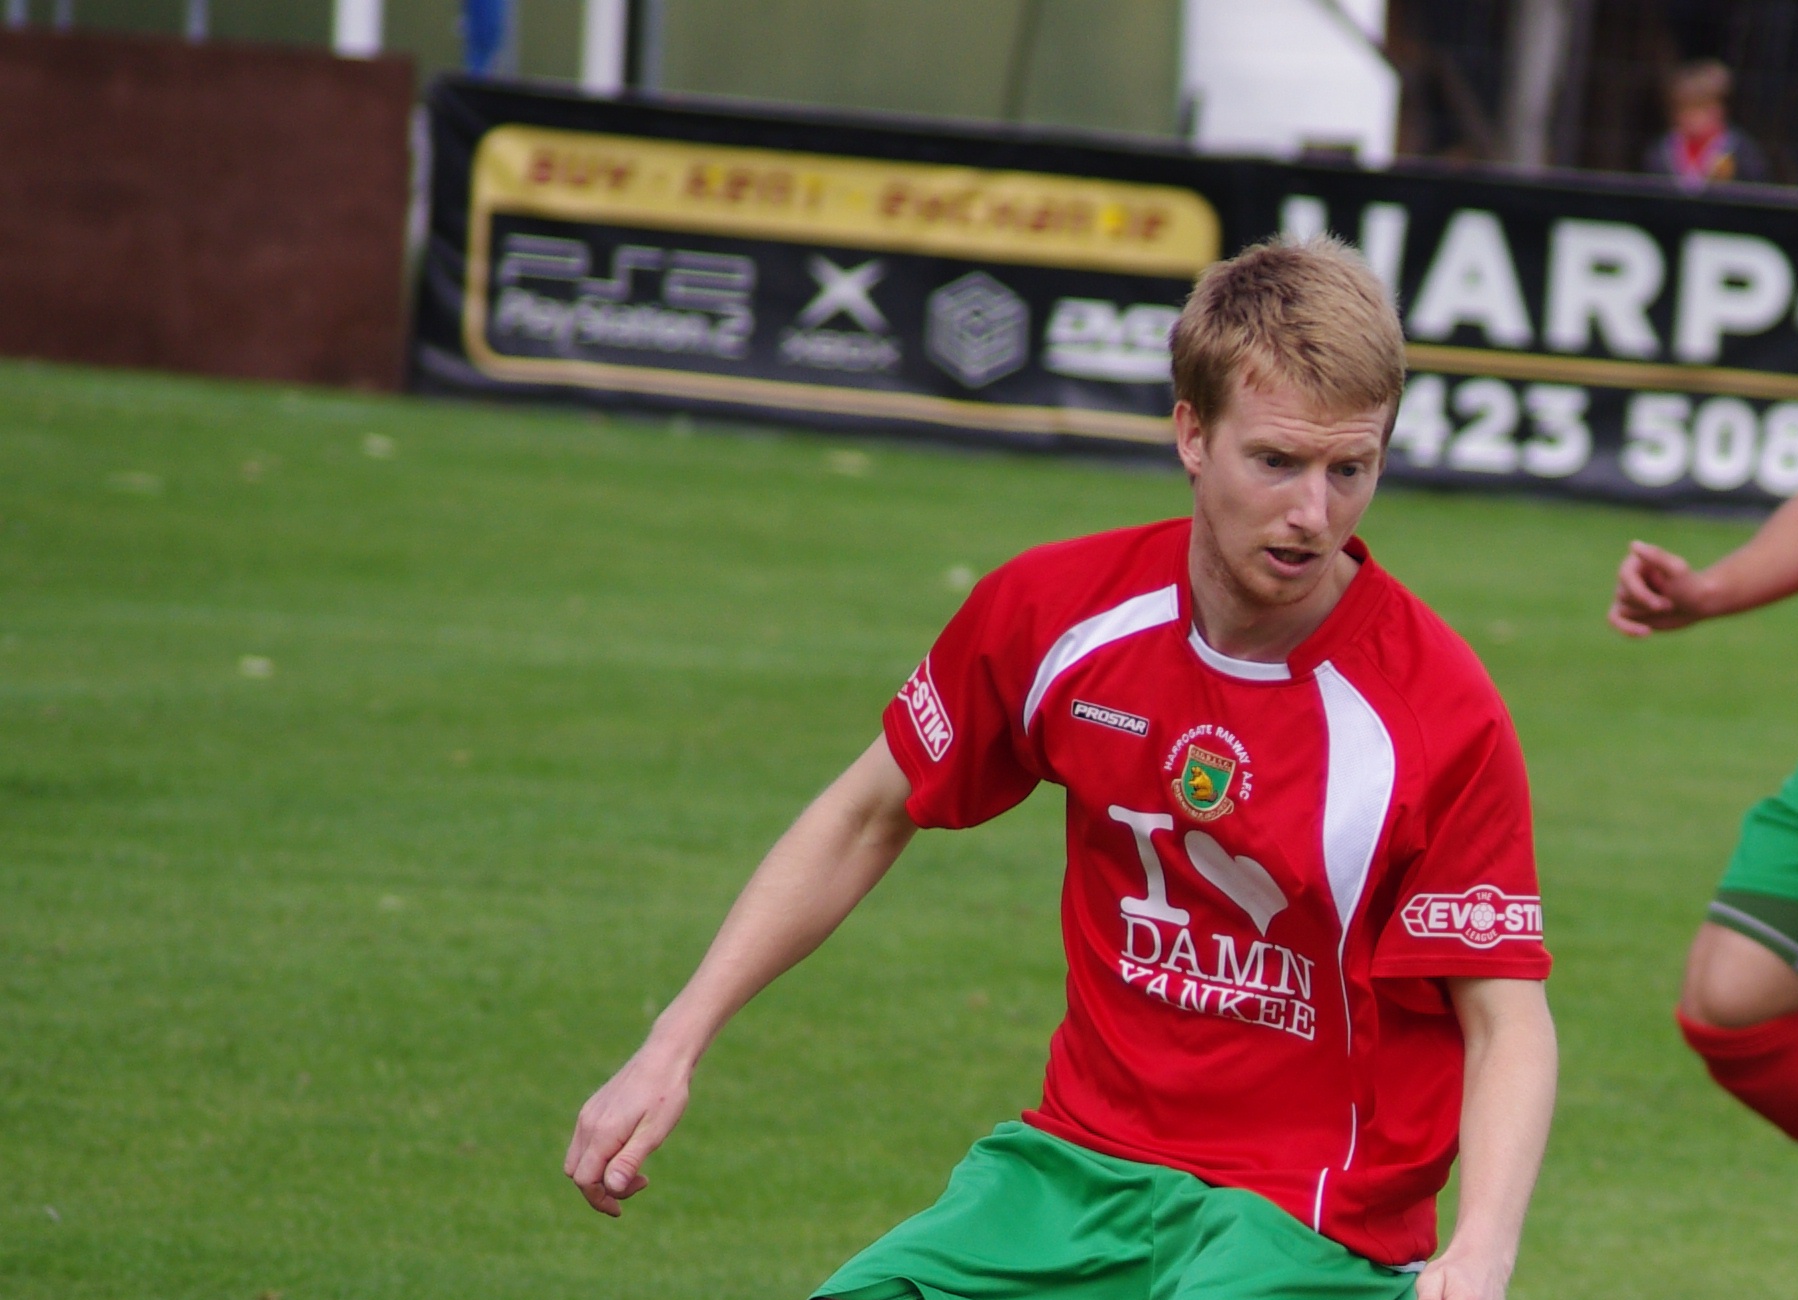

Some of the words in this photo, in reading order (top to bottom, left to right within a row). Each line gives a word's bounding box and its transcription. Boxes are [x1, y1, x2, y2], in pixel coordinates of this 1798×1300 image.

[1074, 703, 1147, 734] PROSTAR
[1164, 724, 1213, 771] HARROGATE
[1215, 726, 1251, 764] RAILWAY
[1107, 804, 1190, 926] I
[1476, 892, 1493, 901] THE
[1120, 913, 1315, 1000] DAMN
[1465, 928, 1498, 942] LEAGUE
[1119, 959, 1316, 1041] YANKEE
